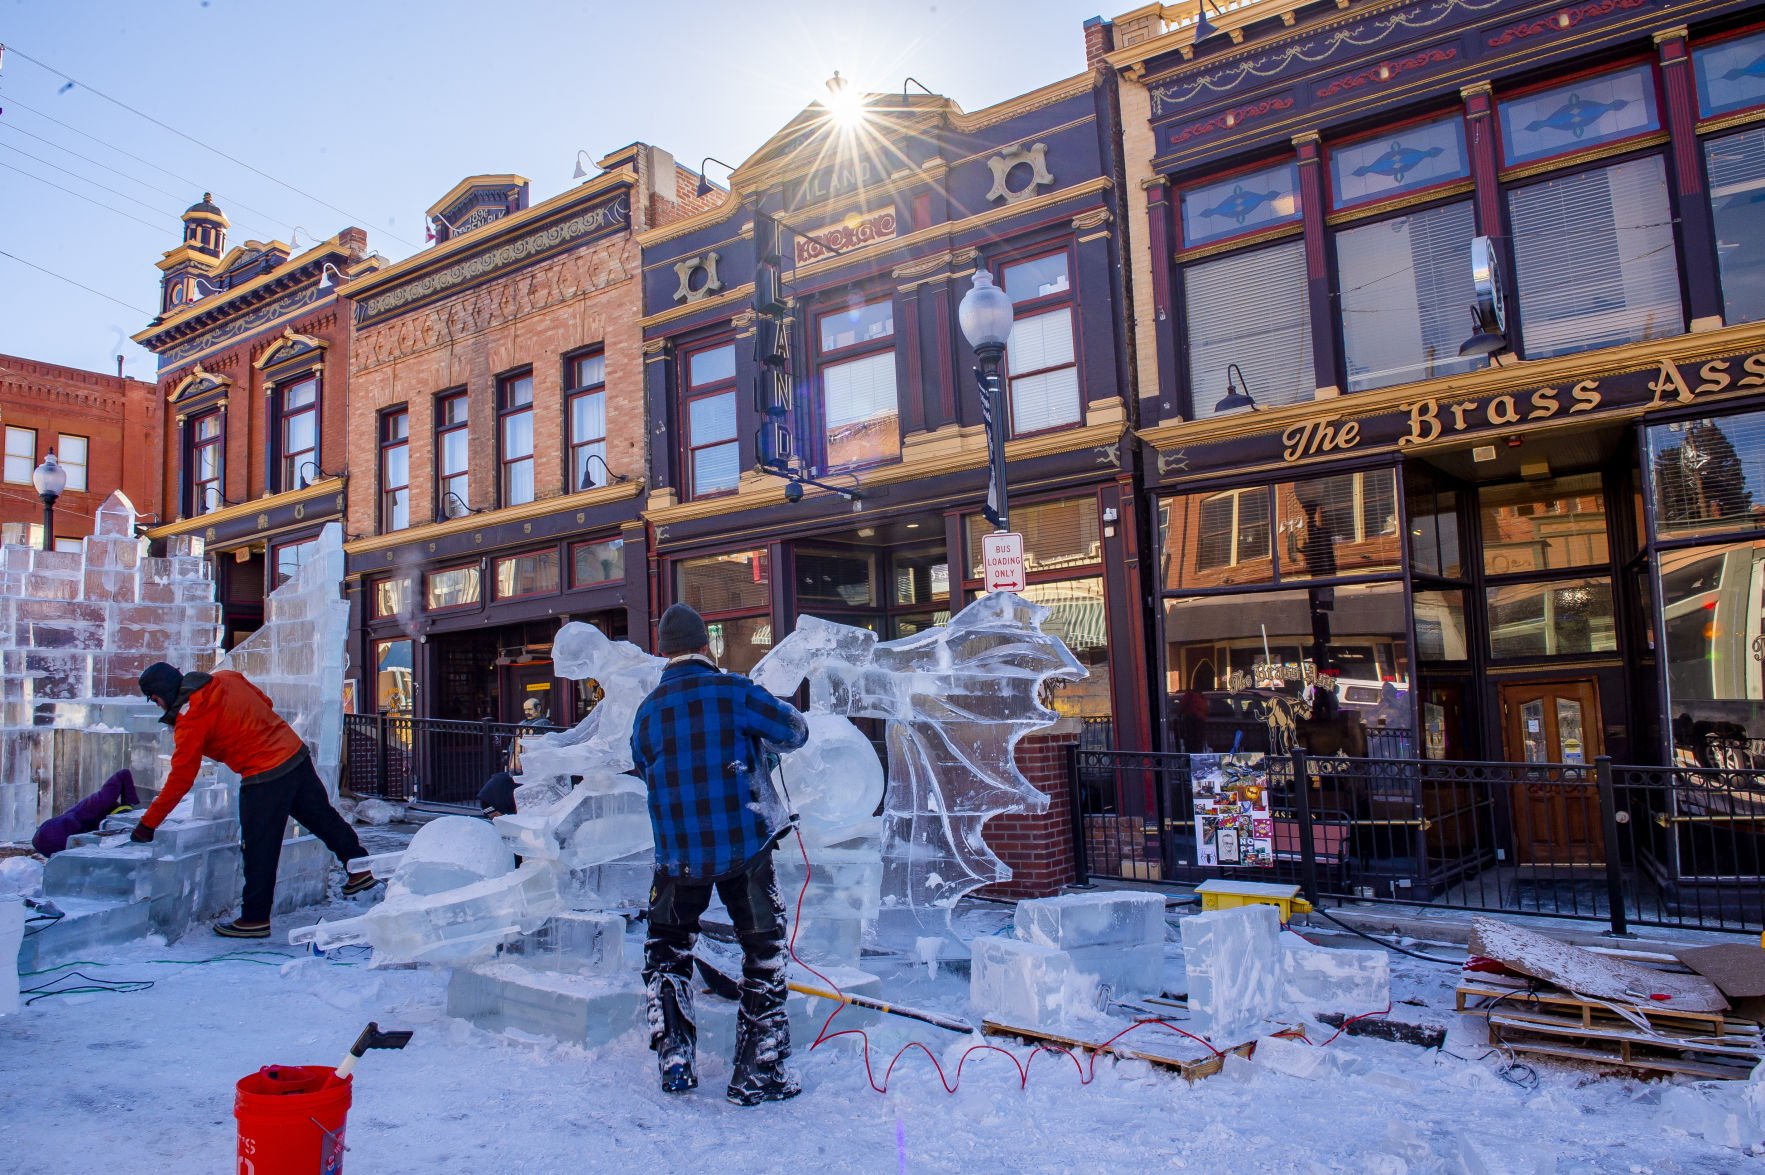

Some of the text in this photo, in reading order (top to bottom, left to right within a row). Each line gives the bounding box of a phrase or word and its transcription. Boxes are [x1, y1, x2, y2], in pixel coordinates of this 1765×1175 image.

[1282, 353, 1765, 462] The Brass Ass
[995, 545, 1011, 553] BUS
[987, 556, 1021, 567] LOADING
[994, 569, 1015, 578] ONLY
